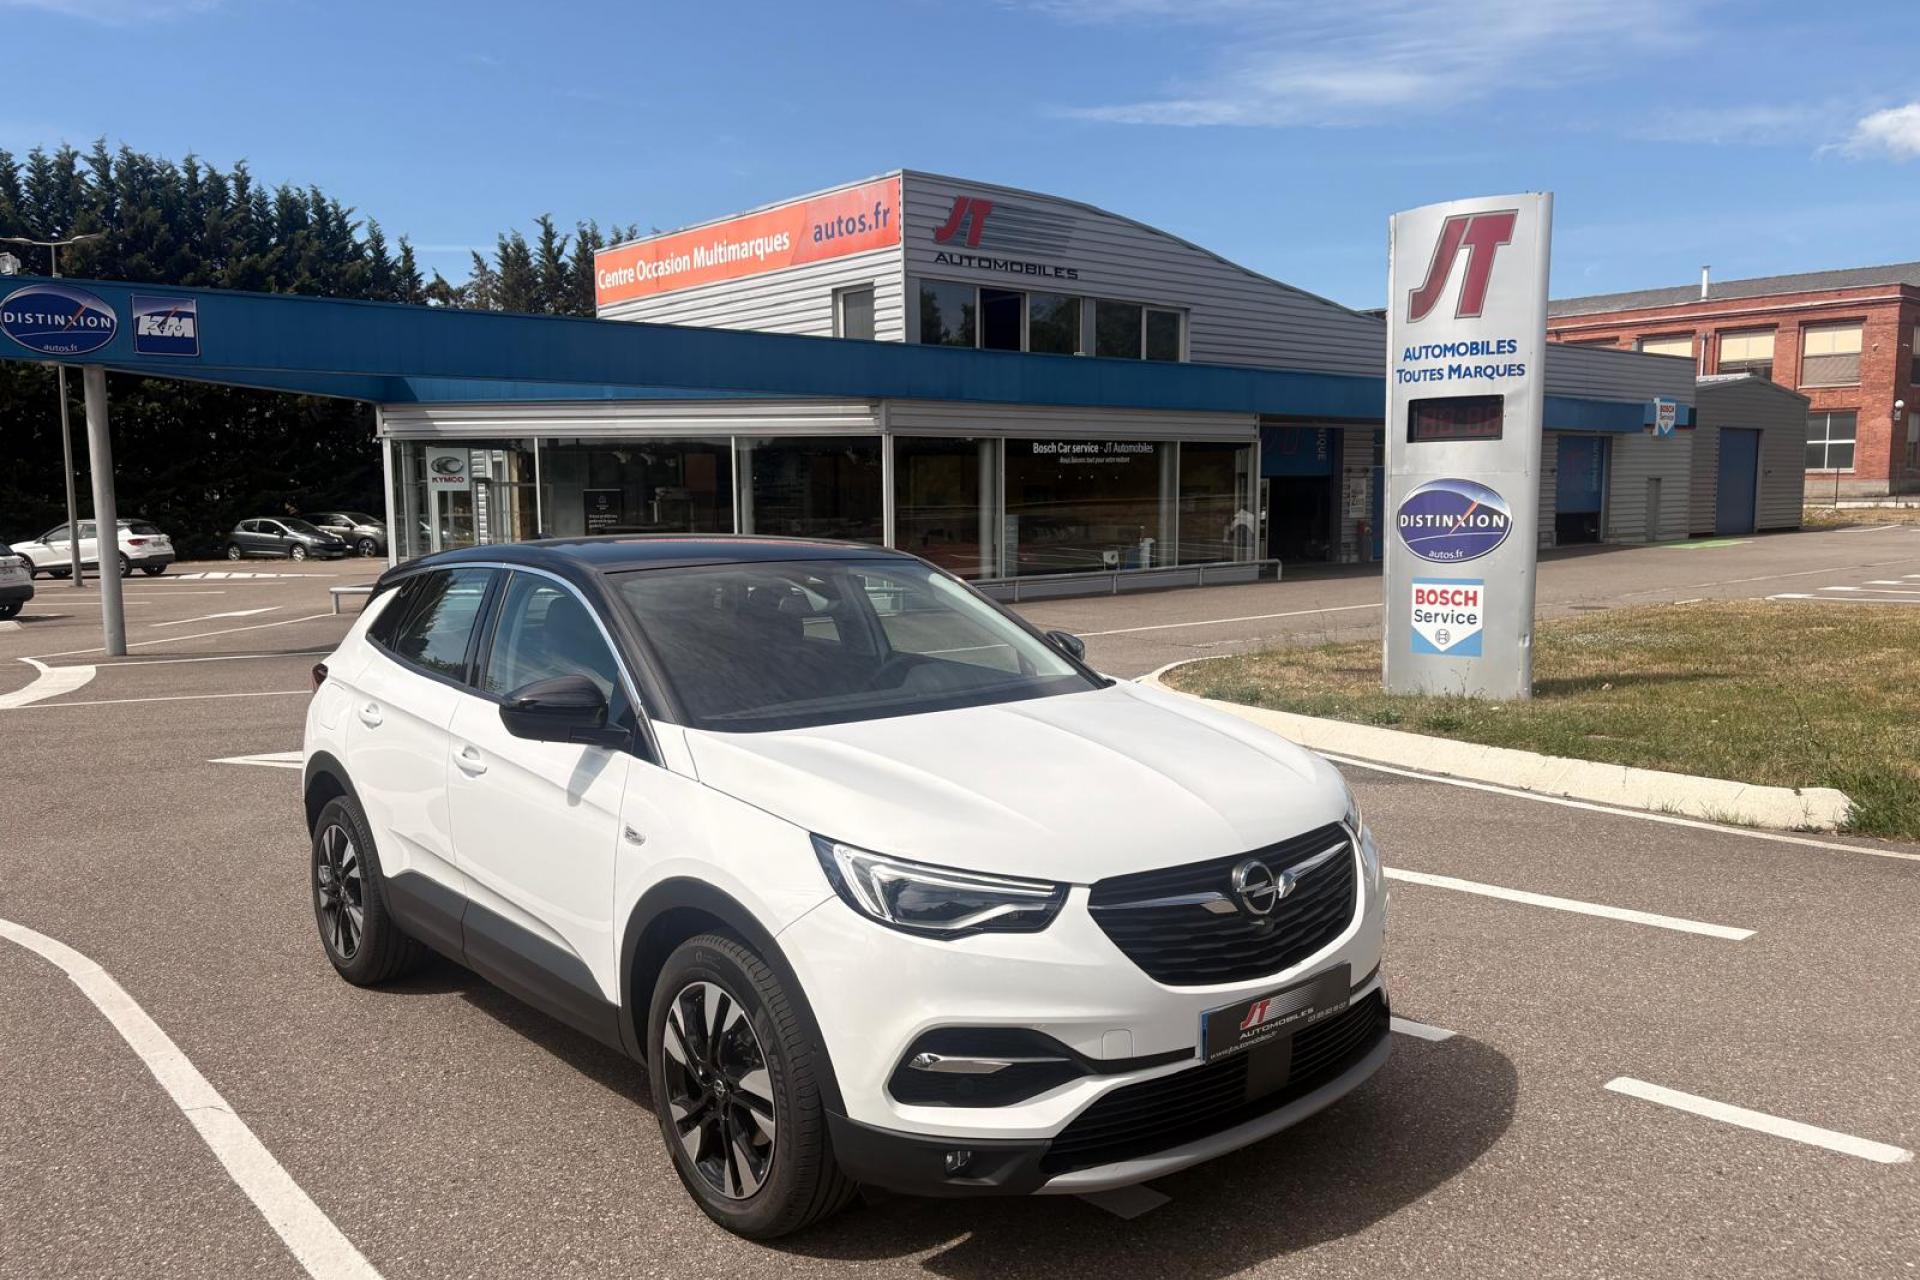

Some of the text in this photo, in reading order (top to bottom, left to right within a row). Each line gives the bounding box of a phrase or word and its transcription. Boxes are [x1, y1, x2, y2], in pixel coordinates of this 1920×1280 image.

[813, 201, 890, 243] autos.fr
[934, 195, 993, 248] JT
[598, 232, 790, 289] Centre Occasion Multimarques
[934, 252, 1078, 280] AUTOMOBILES
[1406, 208, 1519, 324] JT
[3, 310, 112, 329] DISTINXION
[1403, 339, 1518, 362] AUTOMOBILES
[1032, 442, 1057, 453] Bosch
[1058, 442, 1071, 453] Car
[1072, 442, 1099, 453] service
[1104, 442, 1112, 453] JT
[1114, 442, 1154, 453] Automobiles
[1401, 514, 1505, 528] DISTINXION
[1428, 549, 1464, 559] autos.fr
[1415, 588, 1478, 607] BOSCH
[1414, 609, 1478, 625] Service
[1240, 998, 1272, 1031] JT
[1240, 1007, 1314, 1040] AUTOMOBILES
